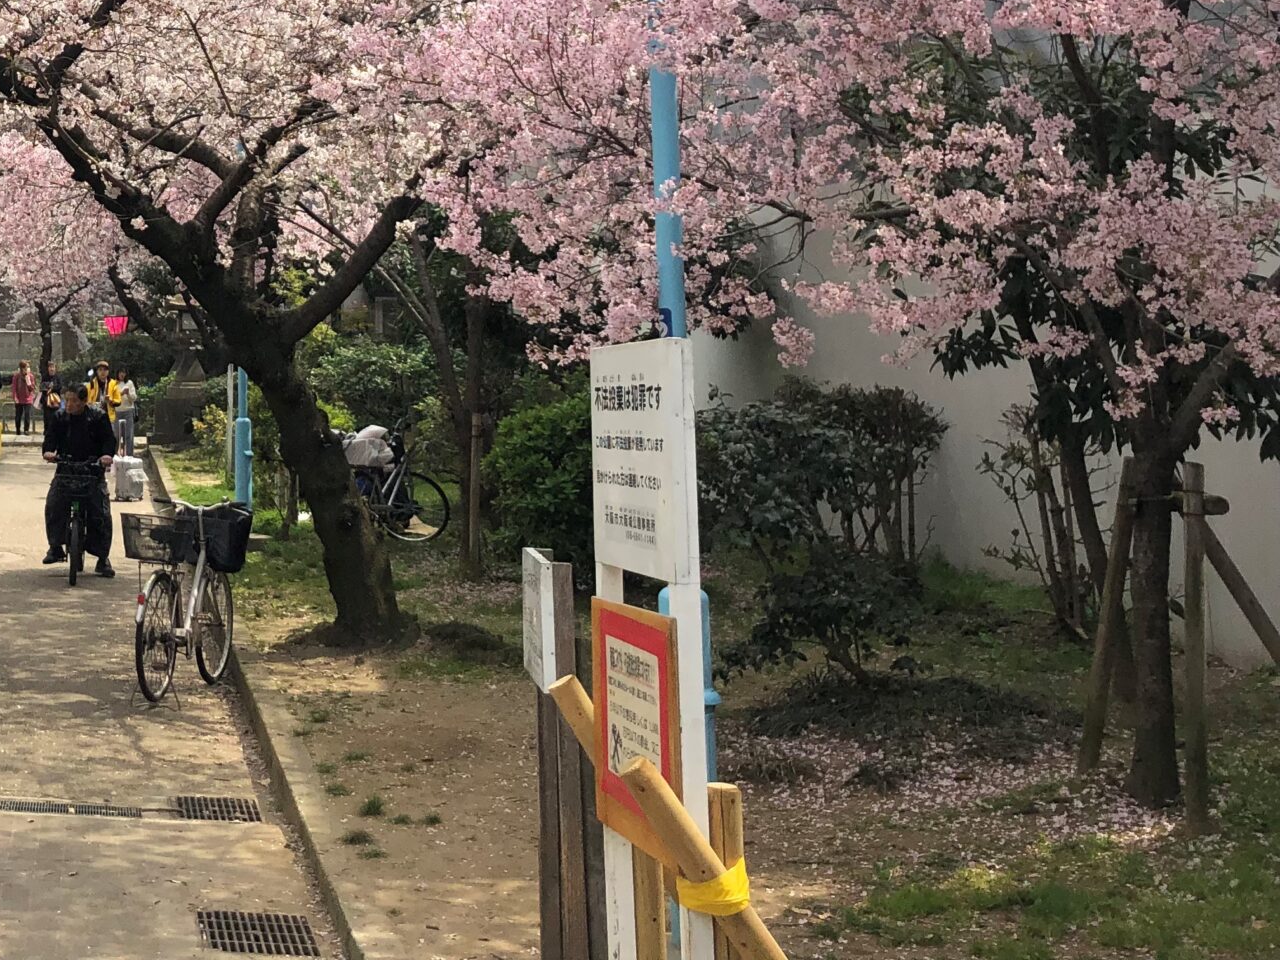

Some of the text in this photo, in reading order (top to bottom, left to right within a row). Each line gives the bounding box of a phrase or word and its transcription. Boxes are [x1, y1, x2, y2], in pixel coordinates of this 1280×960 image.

[594, 383, 662, 411] 不法投棄は犯罪です
